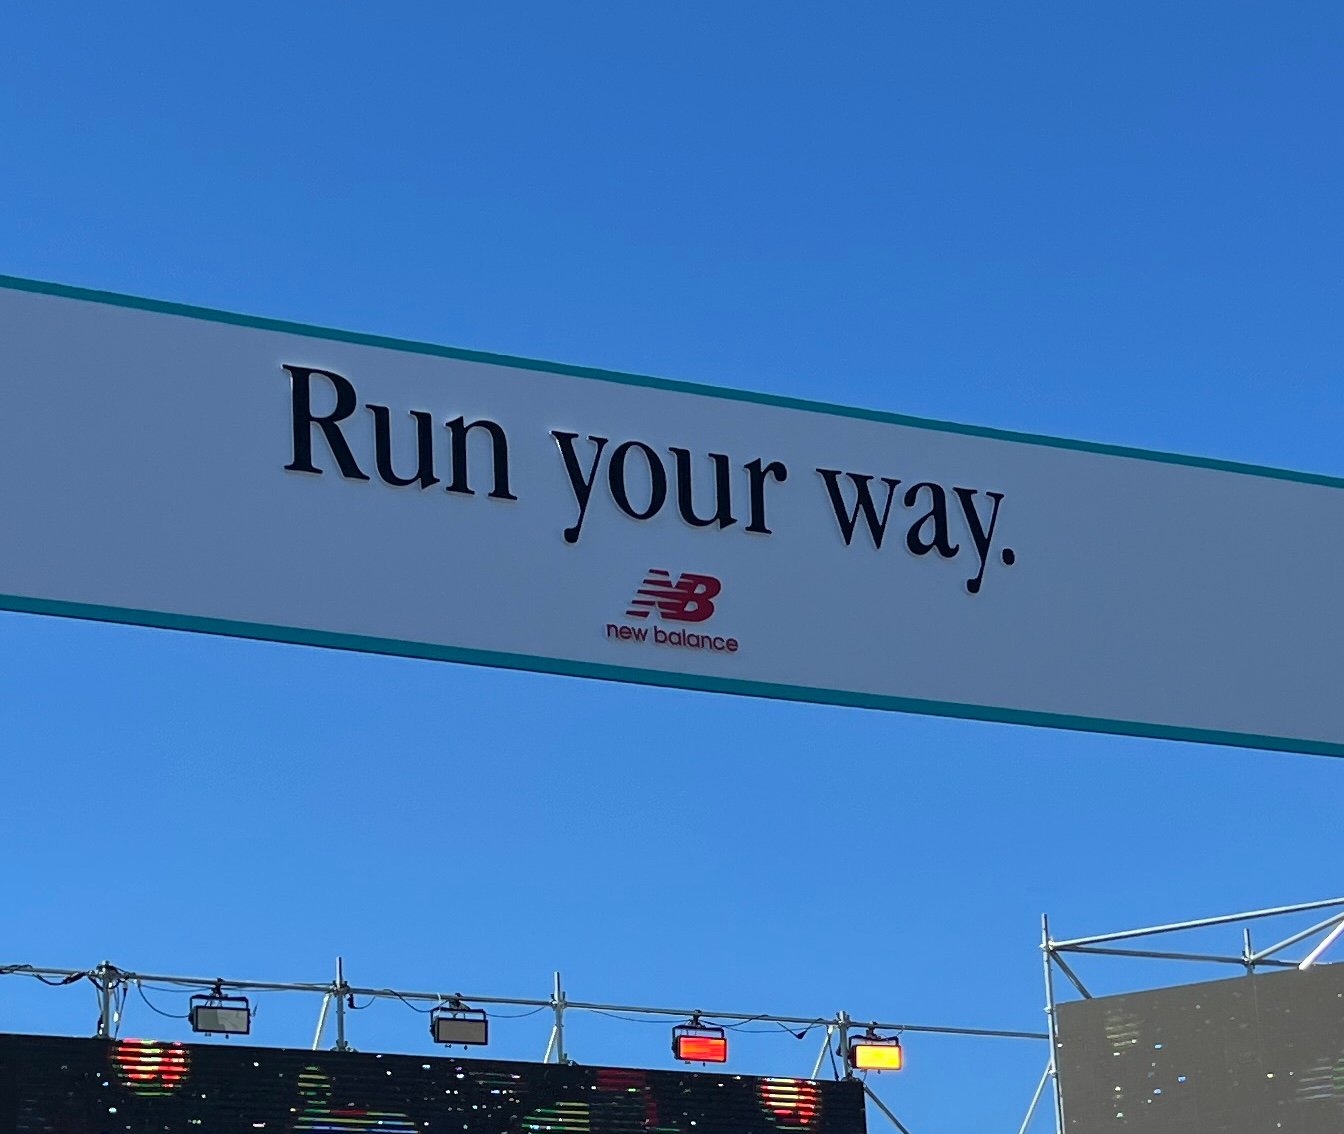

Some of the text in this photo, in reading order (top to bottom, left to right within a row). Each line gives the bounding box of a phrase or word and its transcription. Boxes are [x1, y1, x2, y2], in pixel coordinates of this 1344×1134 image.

[281, 363, 1017, 594] Run your way.
[625, 568, 722, 624] NB
[606, 623, 738, 652] new balance
